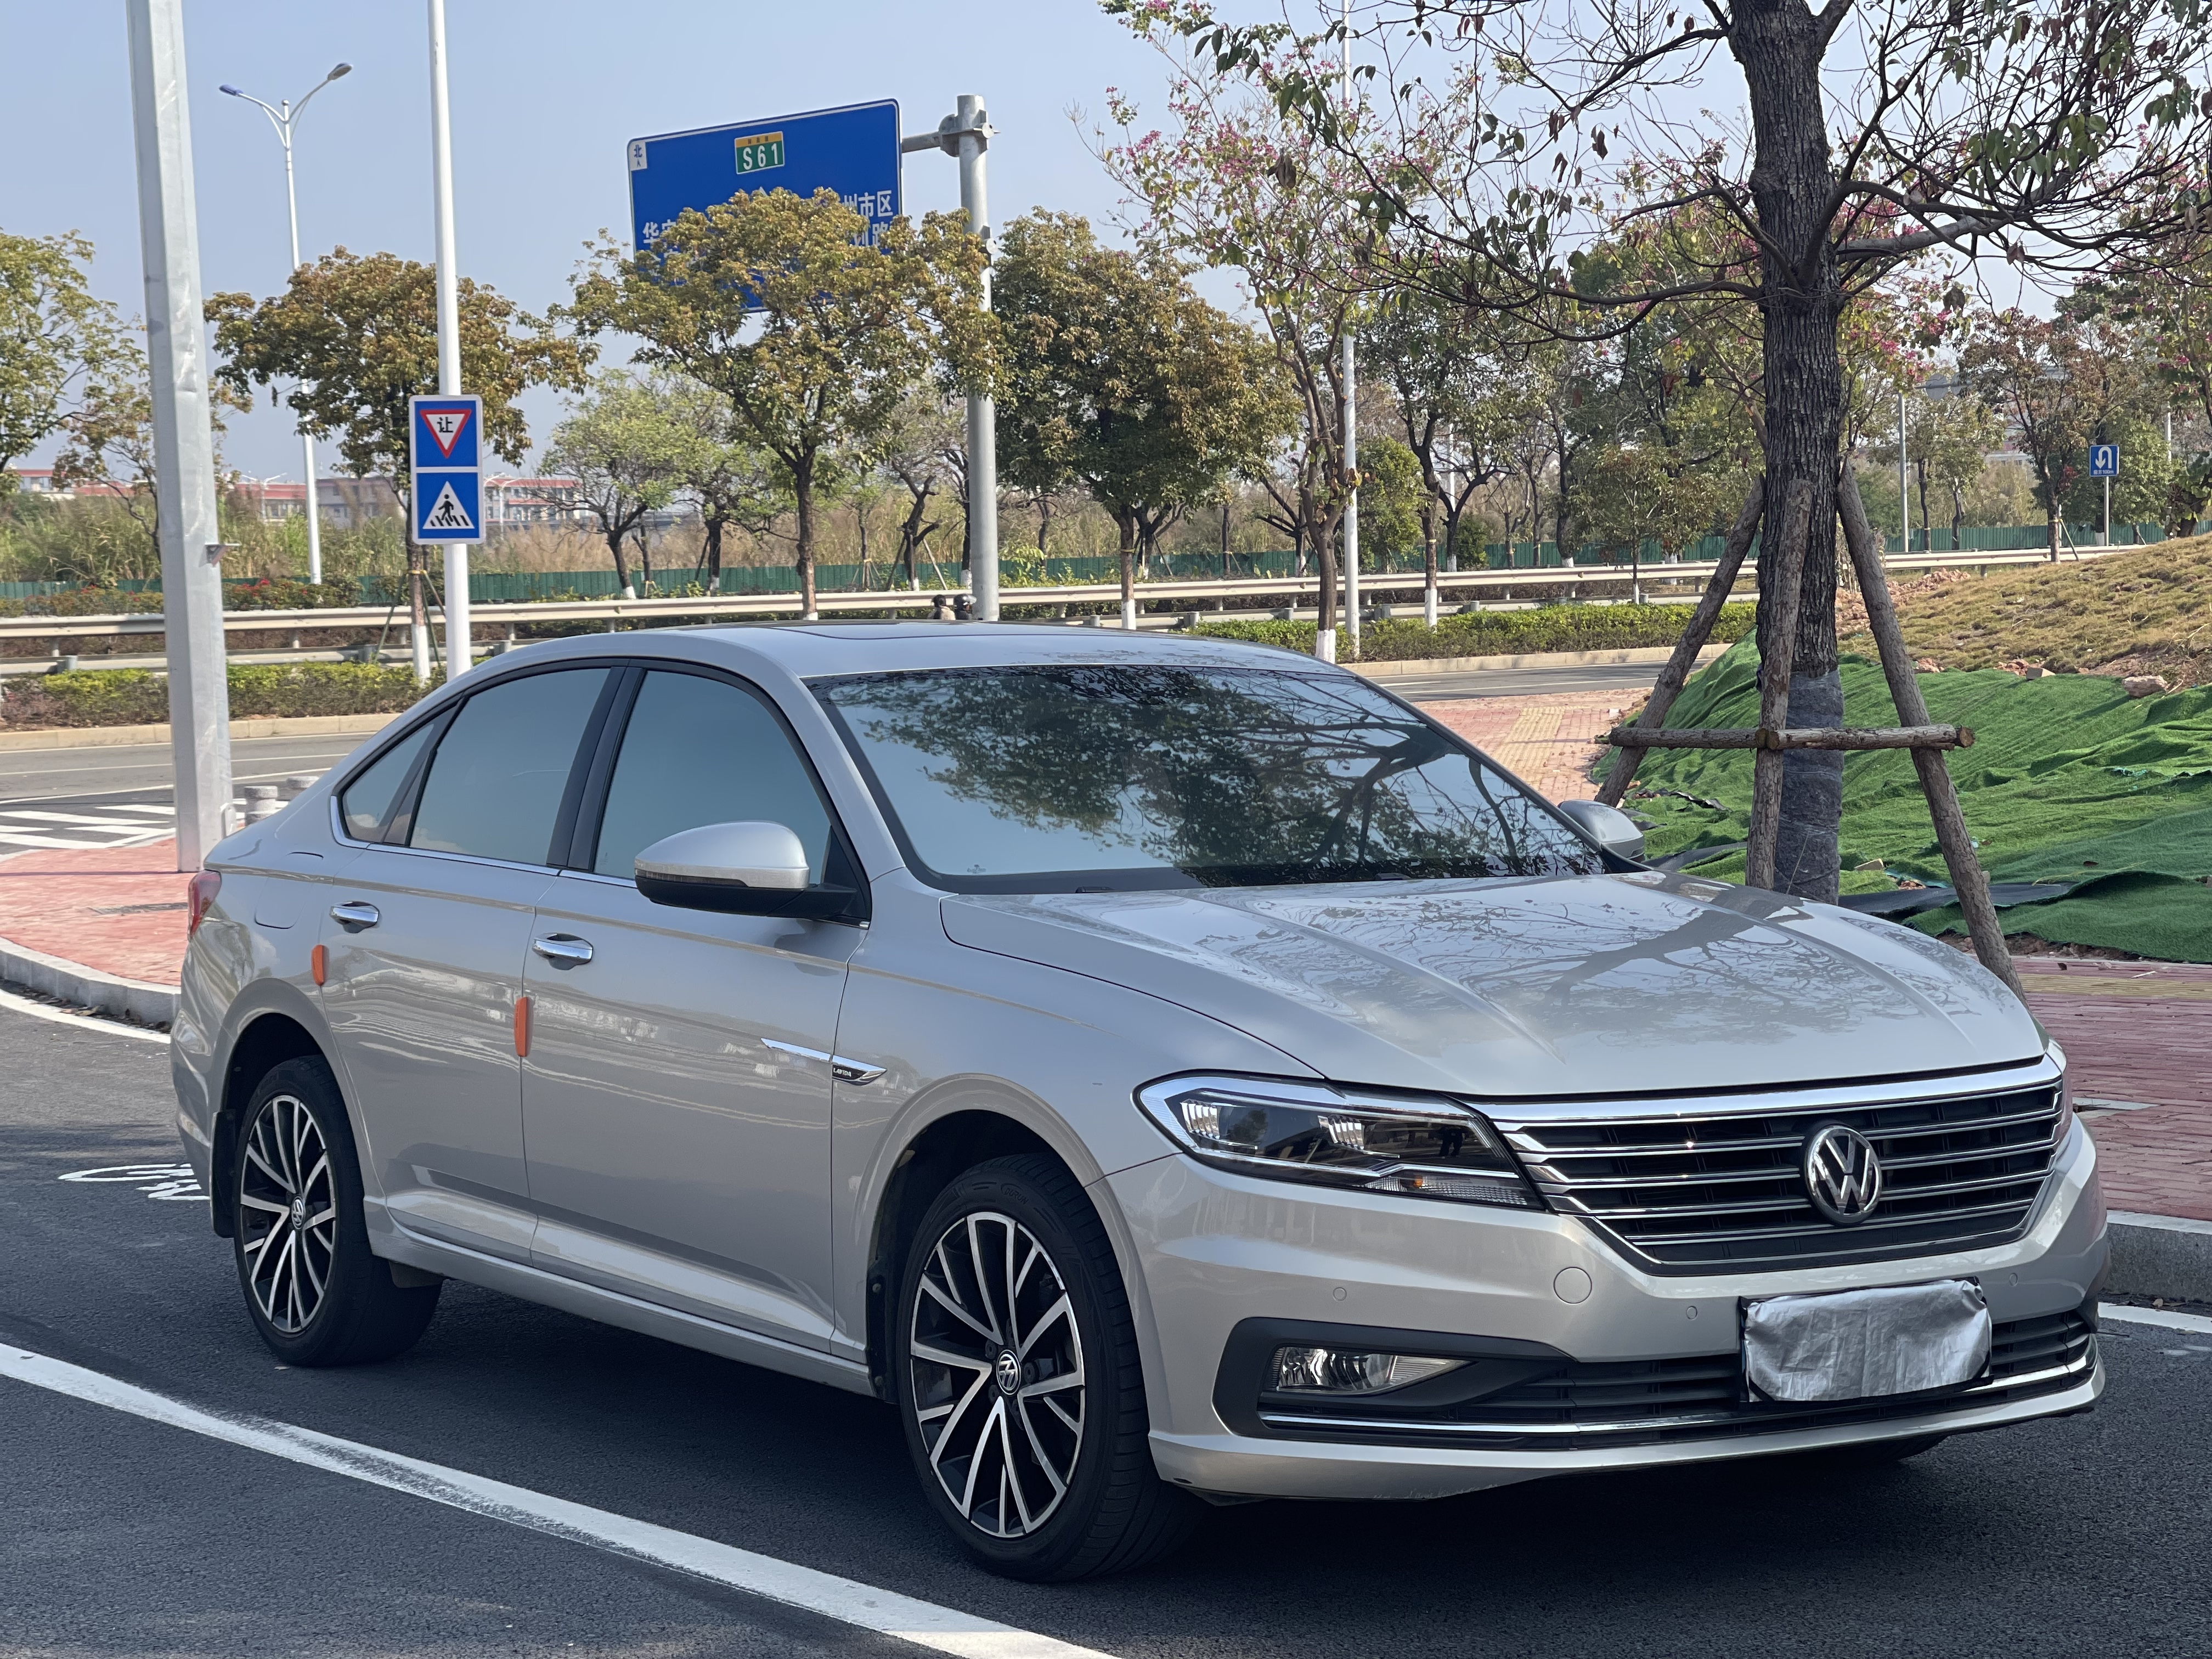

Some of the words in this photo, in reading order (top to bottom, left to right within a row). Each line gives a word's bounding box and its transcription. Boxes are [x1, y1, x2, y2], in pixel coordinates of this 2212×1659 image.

[634, 144, 642, 158] 北
[743, 143, 778, 170] S61
[437, 416, 454, 433] 让
[833, 1068, 852, 1077] LAVIDA
